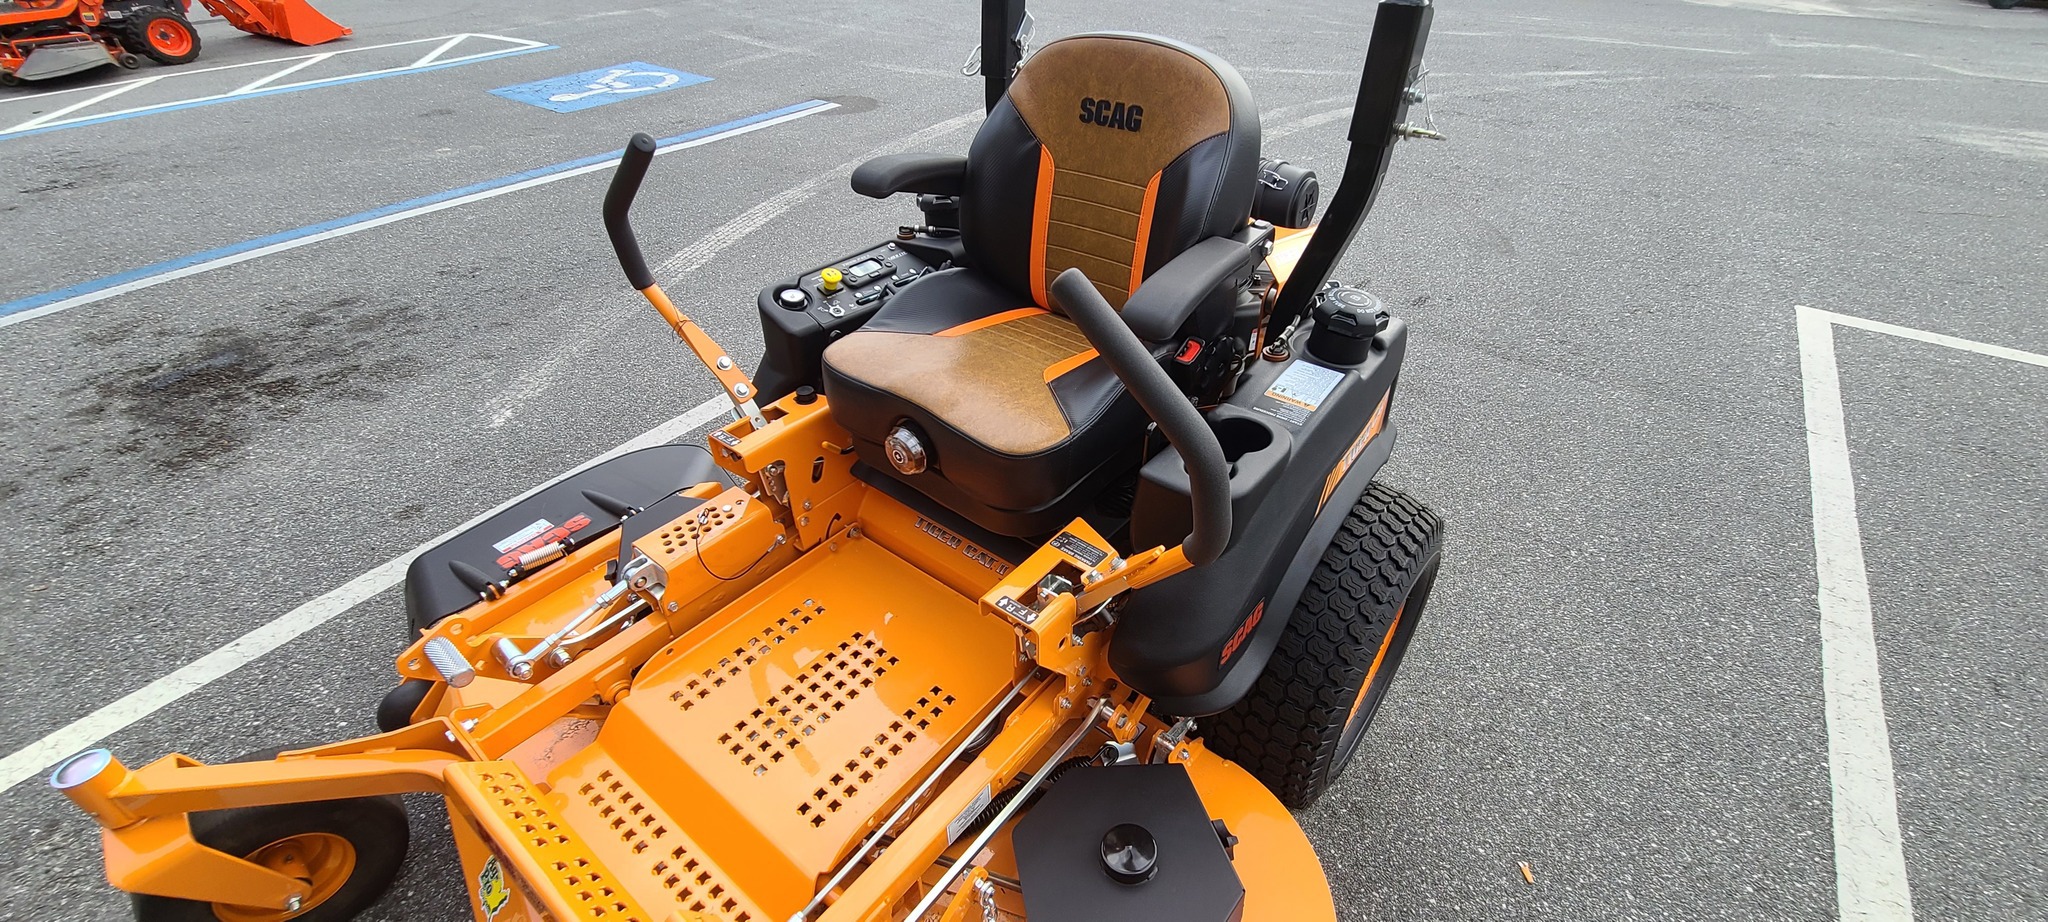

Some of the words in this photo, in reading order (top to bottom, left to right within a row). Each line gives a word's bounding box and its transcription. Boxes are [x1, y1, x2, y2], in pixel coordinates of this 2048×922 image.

[1079, 97, 1143, 132] SCAG
[496, 515, 591, 568] SCAG
[962, 544, 999, 569] CAT
[1220, 600, 1265, 665] SCAG
